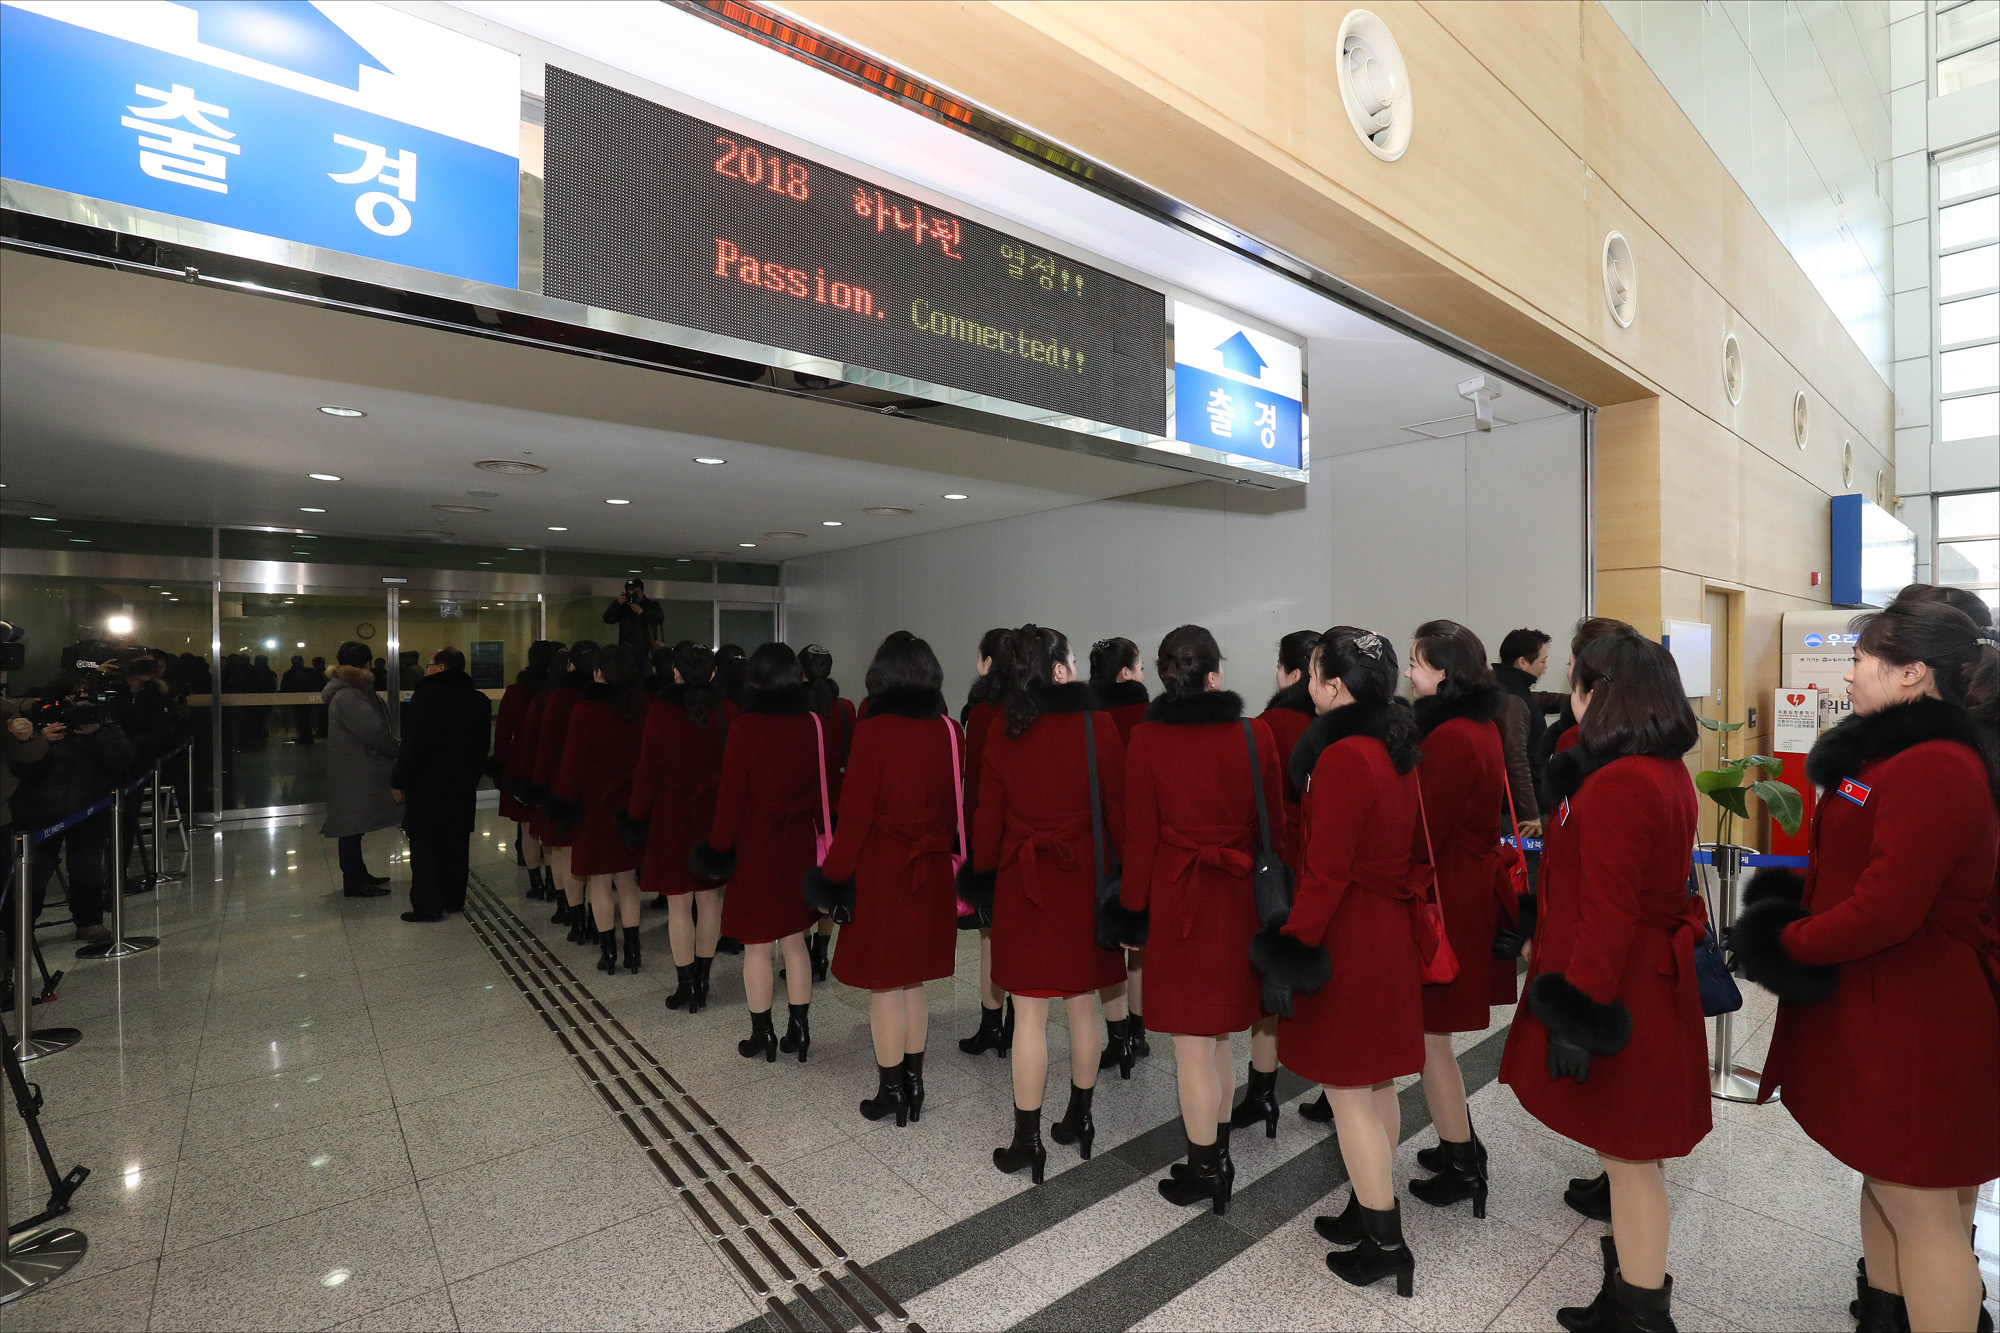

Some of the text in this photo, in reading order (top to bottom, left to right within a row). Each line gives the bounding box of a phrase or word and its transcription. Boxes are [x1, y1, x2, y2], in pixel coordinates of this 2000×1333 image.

[715, 137, 1084, 297] 2018 하나된 열정!!
[714, 237, 1085, 373] Passion. Connected!!
